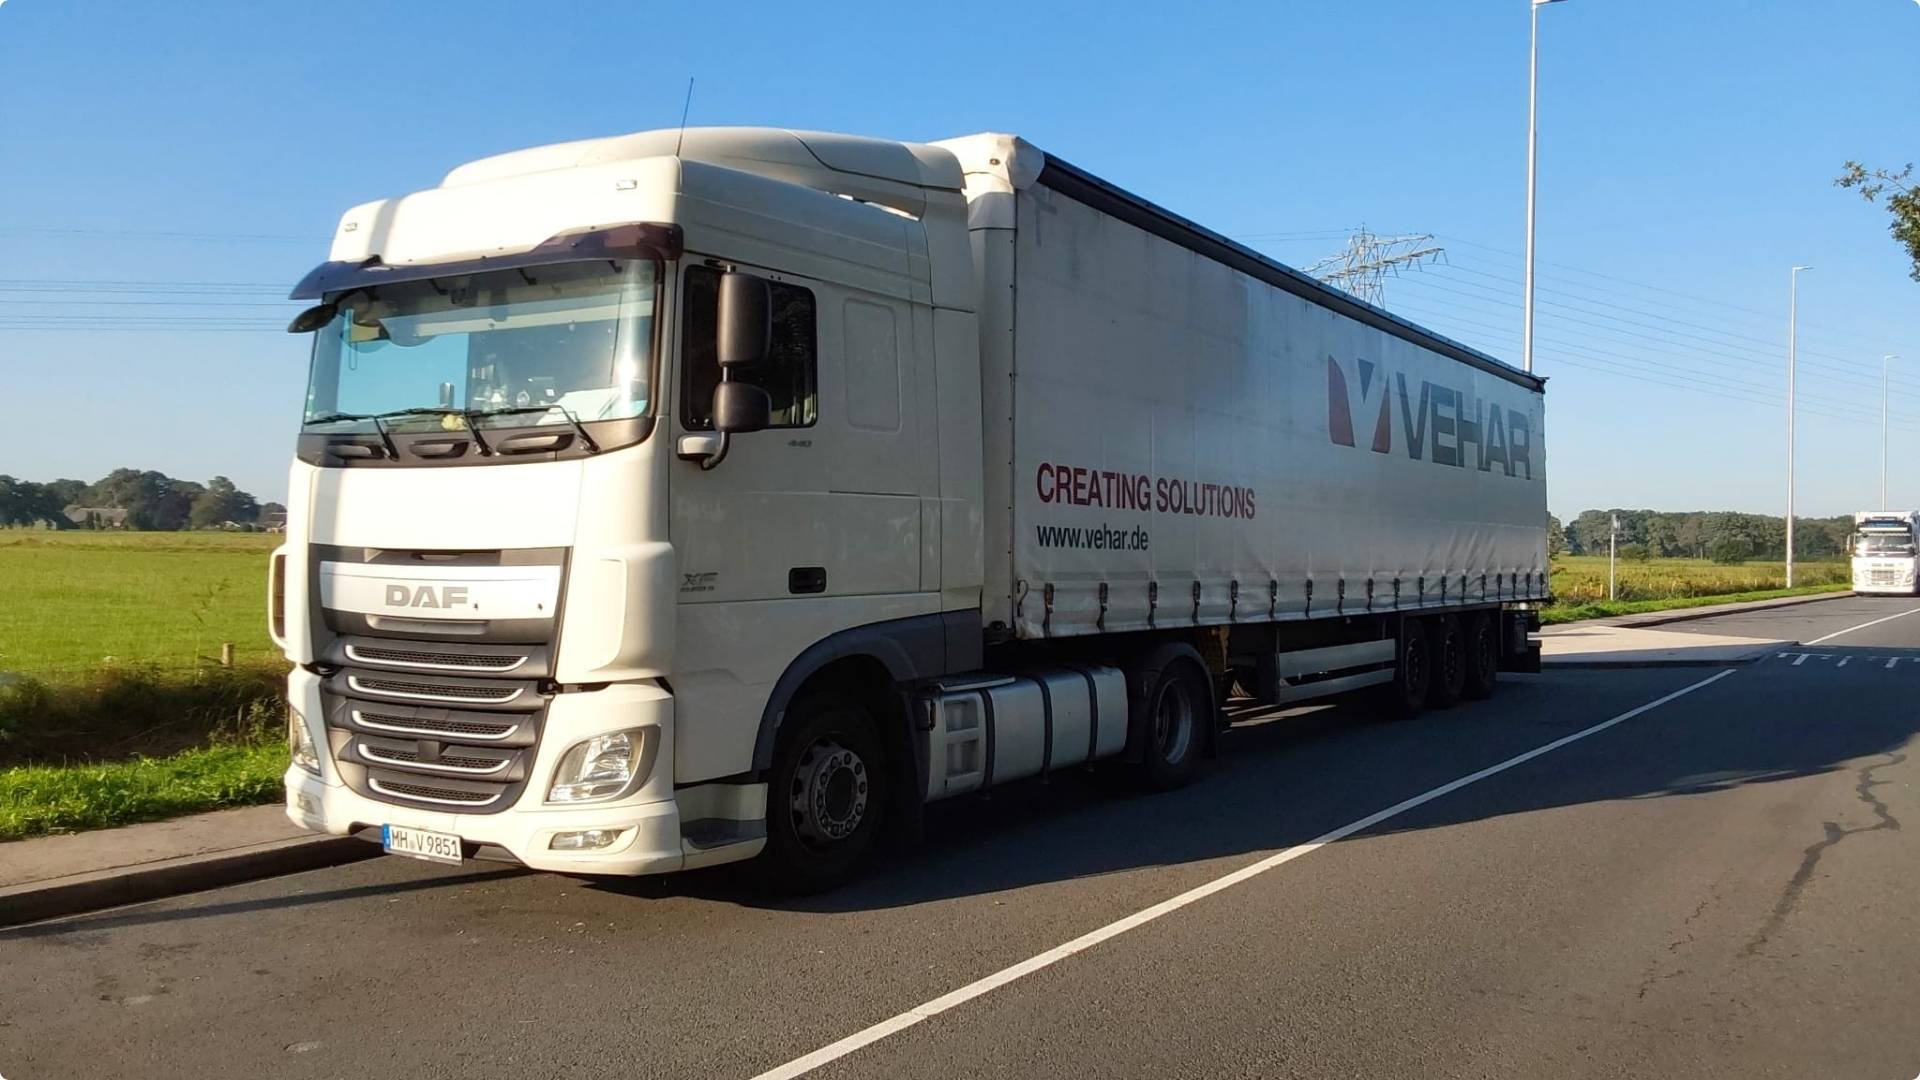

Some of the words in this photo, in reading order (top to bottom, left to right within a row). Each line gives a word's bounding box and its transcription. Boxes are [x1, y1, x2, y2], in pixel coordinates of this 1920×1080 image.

[1396, 371, 1531, 480] VEHAR
[1037, 462, 1150, 511] CREATING
[1156, 477, 1255, 520] SOLUTIONS
[1037, 523, 1149, 551] www.vehar.de
[385, 584, 468, 609] DAF
[391, 829, 408, 849] MH
